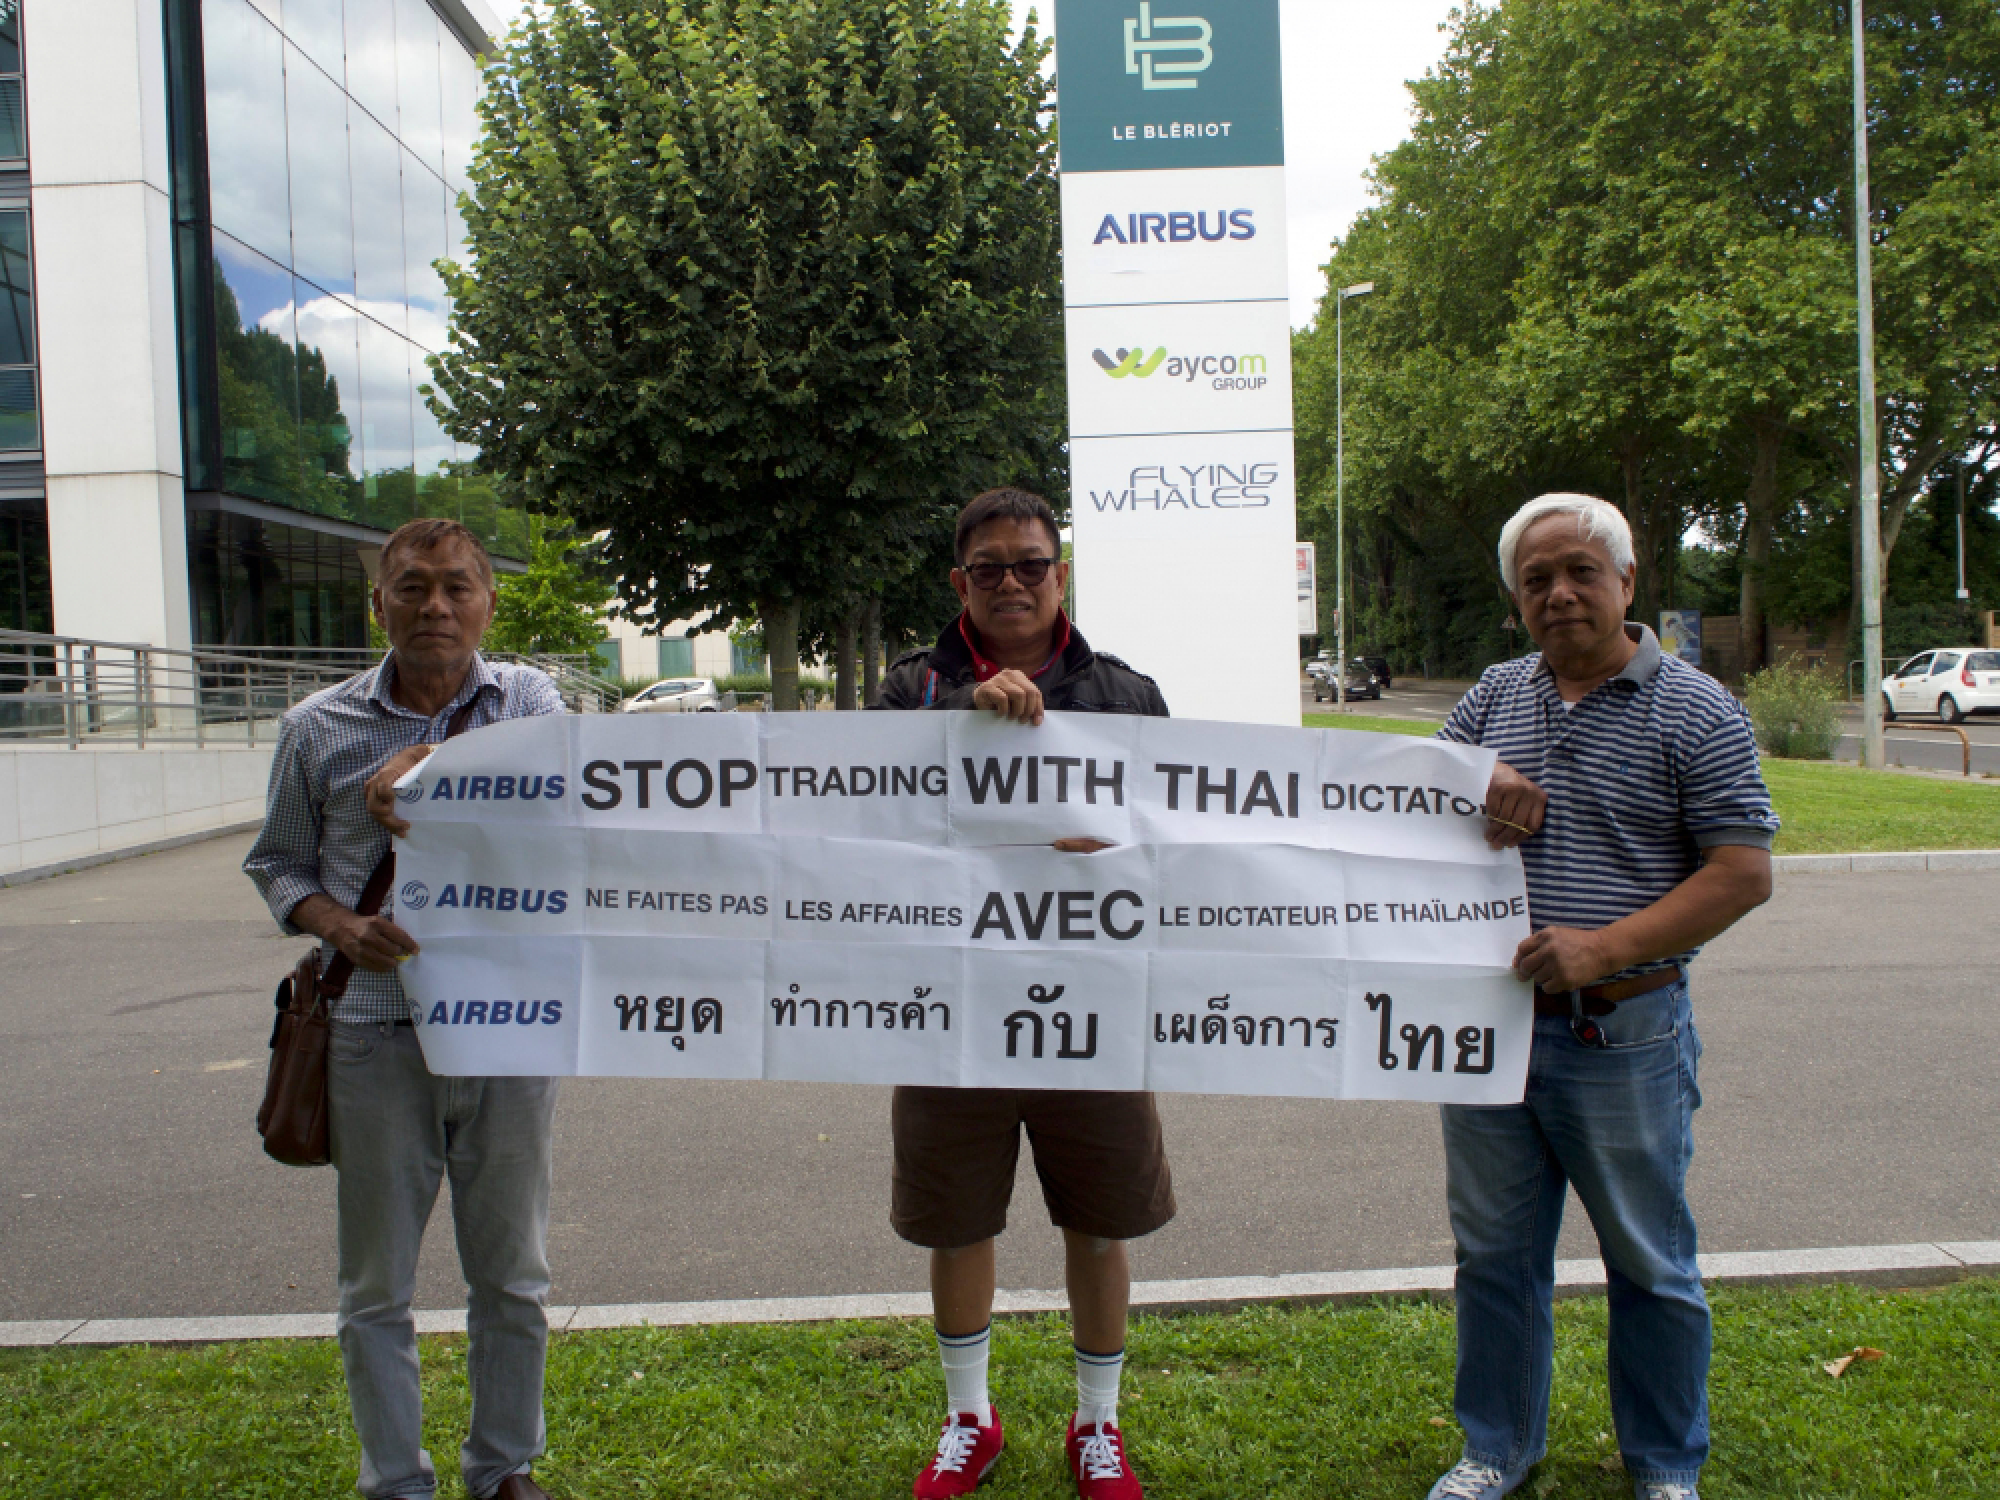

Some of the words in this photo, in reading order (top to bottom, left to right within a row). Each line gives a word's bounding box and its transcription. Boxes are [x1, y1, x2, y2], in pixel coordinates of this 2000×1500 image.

[1112, 125, 1136, 140] LE
[1093, 208, 1257, 245] AIRBUS
[1212, 376, 1267, 391] GROUP
[1129, 462, 1278, 489] FLYING
[1089, 485, 1271, 513] WHALES
[430, 774, 567, 802] AIRBUS
[581, 758, 759, 811] STOP
[765, 764, 949, 798] TRADING
[961, 755, 1125, 807] WITH
[1155, 762, 1299, 818] THAI
[1321, 782, 1487, 817] DICTATO
[435, 883, 569, 915] AIRBUS
[585, 888, 620, 910] NE
[627, 890, 713, 914] FAITES
[719, 894, 769, 916] PAS
[785, 899, 834, 924] LES
[839, 902, 964, 928] AFFAIRES
[970, 889, 1145, 941] AVEC
[1159, 905, 1191, 927] LE
[1198, 905, 1339, 928] DICTATEUR
[1345, 902, 1380, 924] DE
[1384, 894, 1526, 924] THAÏLANDE
[428, 999, 563, 1026] AIRBUS
[613, 993, 724, 1052] หยุด
[770, 983, 952, 1031] ทำการค้า
[1003, 983, 1100, 1060] กับ
[1153, 993, 1341, 1049] เผด็จการ
[1363, 992, 1496, 1075] ไทย
